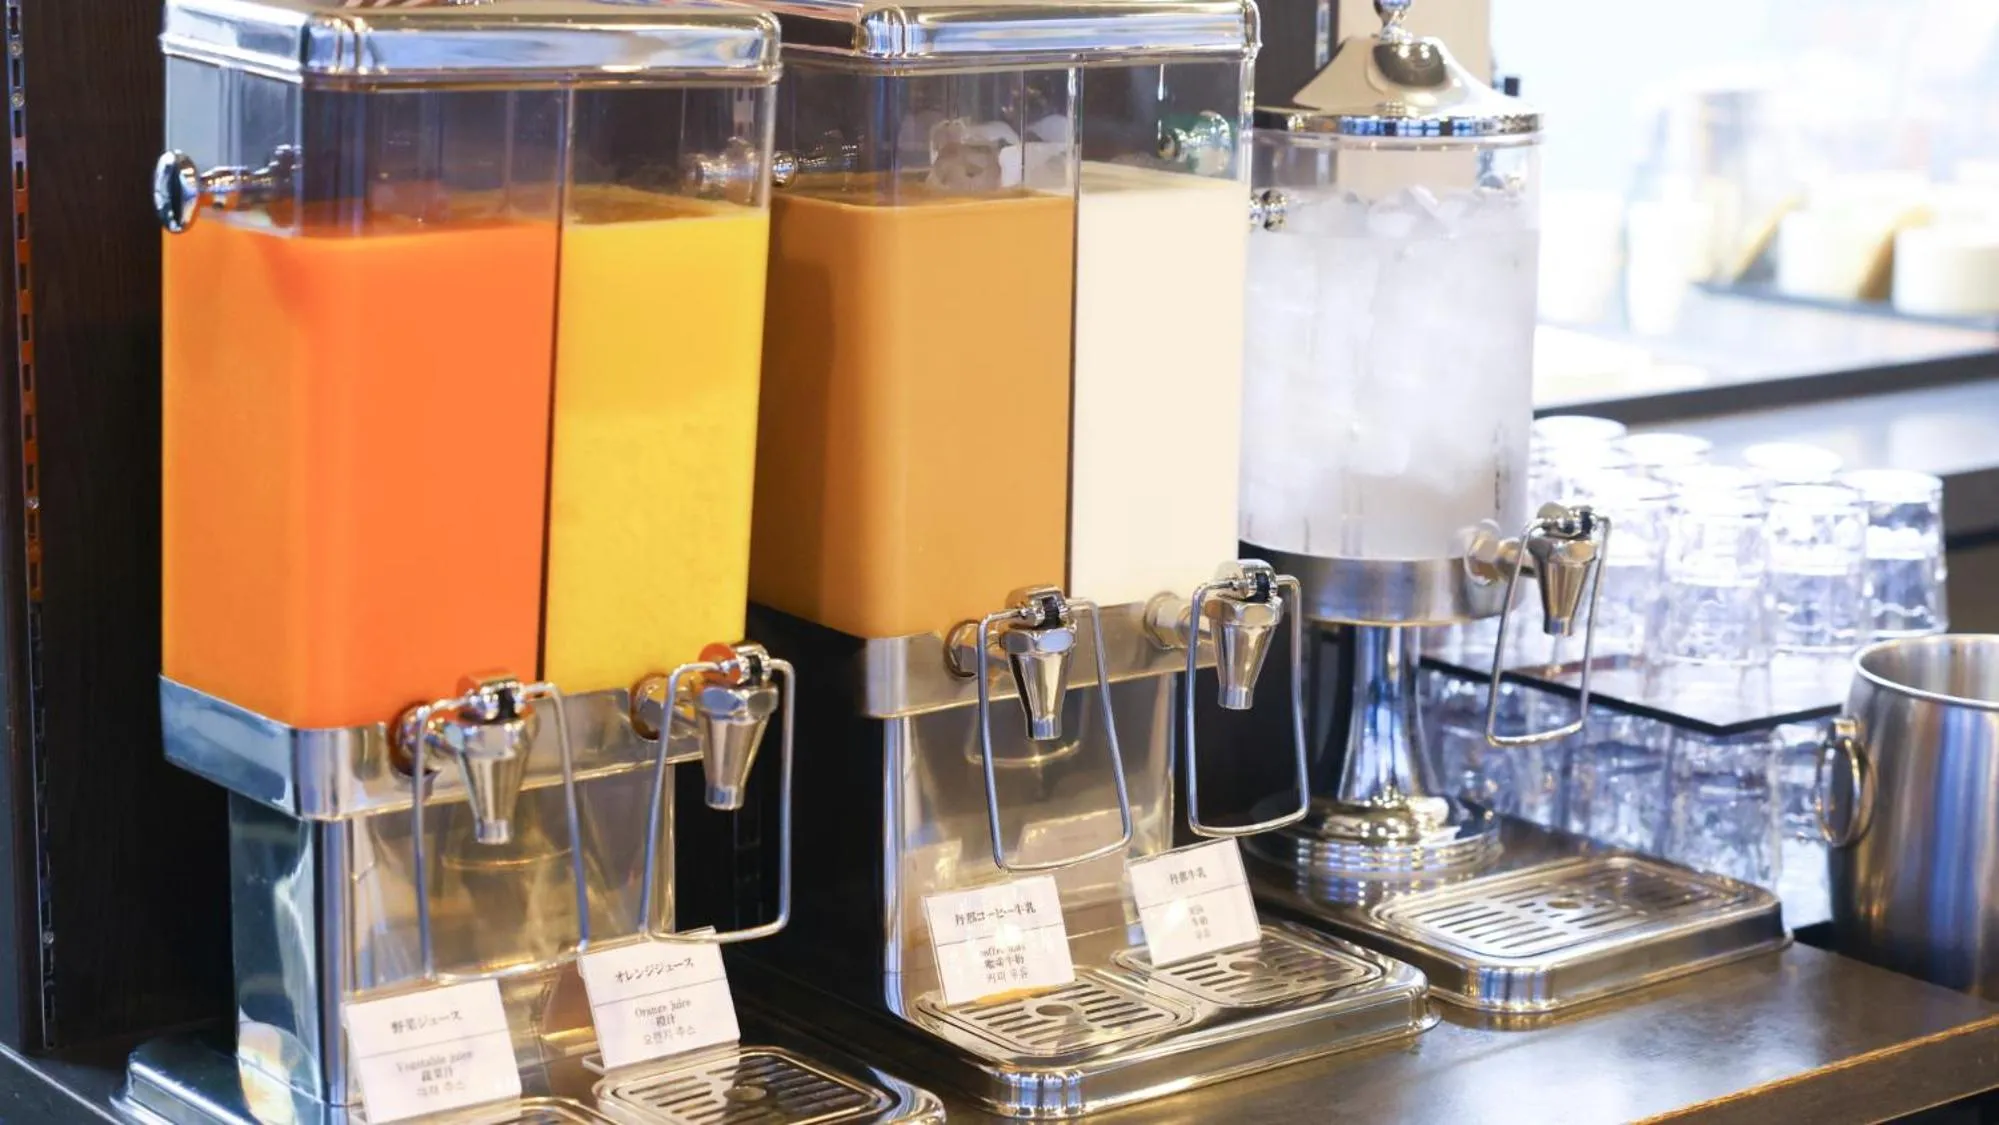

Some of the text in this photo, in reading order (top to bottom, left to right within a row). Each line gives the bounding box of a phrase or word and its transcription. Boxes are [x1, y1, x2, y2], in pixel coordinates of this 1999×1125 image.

[615, 956, 694, 983] オレンジジュース
[391, 1010, 462, 1034] 野菜ジュース
[634, 1002, 667, 1018] Orange
